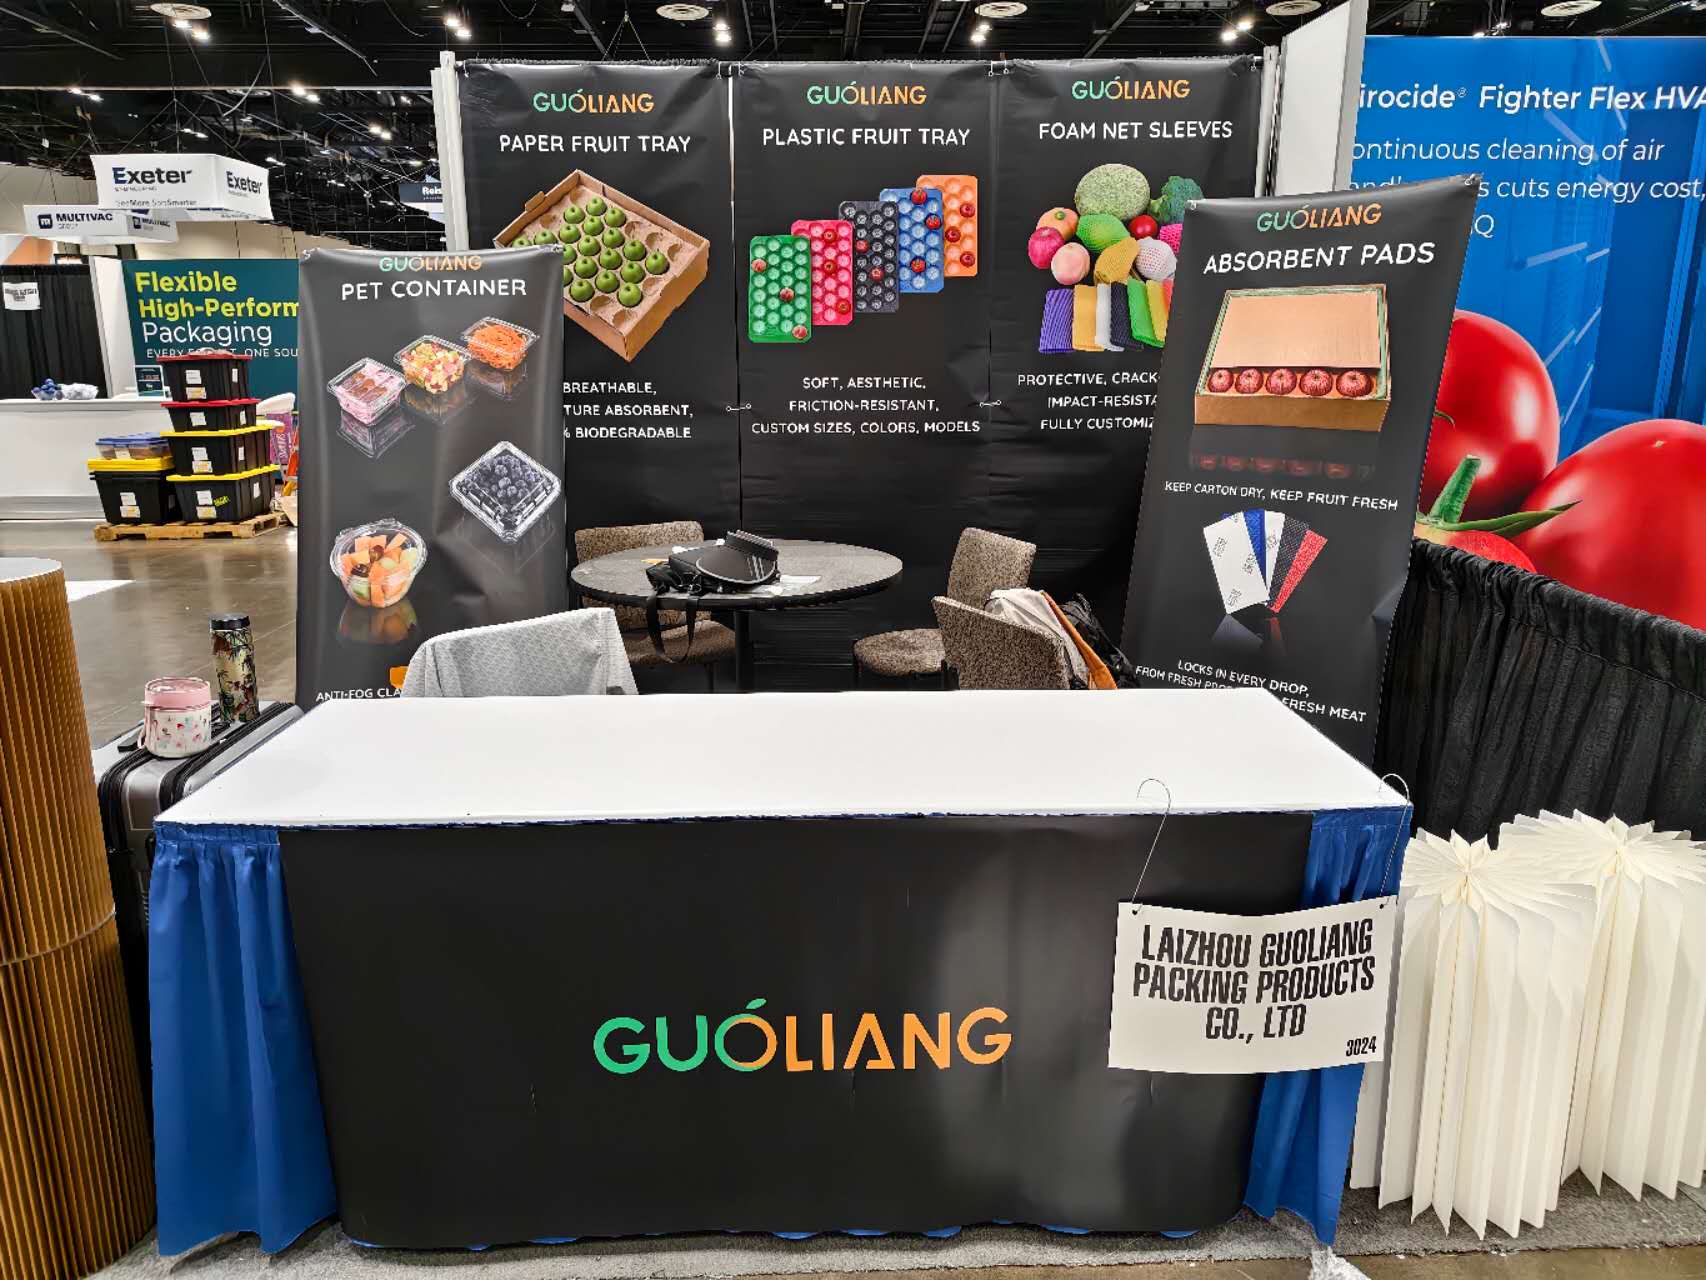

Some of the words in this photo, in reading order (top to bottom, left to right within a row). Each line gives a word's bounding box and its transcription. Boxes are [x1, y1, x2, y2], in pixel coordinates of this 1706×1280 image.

[1479, 84, 1581, 114] Fighter
[1589, 86, 1646, 110] Flex
[763, 128, 845, 146] PLASTIC
[852, 128, 911, 145] FRUIT
[918, 128, 970, 146] TRAY
[1039, 122, 1096, 140] FOAM
[1103, 122, 1143, 139] NET
[1149, 120, 1233, 138] SLEEVES
[499, 134, 564, 152] PAPER
[571, 135, 630, 153] FRUIT
[637, 135, 691, 153] TRAY
[1487, 138, 1594, 166] cleaning
[1602, 138, 1627, 160] of
[1632, 138, 1664, 160] air
[112, 167, 192, 184] Exeter
[226, 170, 263, 195] Exeter
[1496, 177, 1549, 198] cuts
[1556, 180, 1644, 203] energy
[1650, 178, 1706, 202] cost,
[56, 213, 113, 222] MULTIVAC
[1203, 245, 1352, 274] ABSORBENT
[1360, 242, 1436, 266] PADS
[134, 271, 237, 293] Flexible
[341, 282, 383, 301] PET
[391, 279, 527, 298] CONTAINER
[138, 297, 299, 321] High-Perform
[142, 321, 272, 346] Packaging
[244, 348, 270, 358] ONE
[274, 348, 298, 358] SOU
[563, 382, 657, 396] BREATHABLE,
[802, 377, 844, 391] SOFT,
[1017, 373, 1107, 386] PROTECTIVE,
[563, 404, 601, 416] TURE
[604, 404, 693, 418] ABSORBENT,
[575, 426, 691, 439] BIODEGRADABLE
[751, 422, 809, 434] CUSTOM
[813, 422, 856, 436] SIZES,
[924, 421, 981, 433] MODELS
[1040, 418, 1083, 430] FULLY
[1164, 480, 1192, 493] KEEP
[1194, 483, 1237, 496] CARTON
[1240, 487, 1266, 501] DRY,
[1270, 488, 1303, 502] KEEP
[1307, 492, 1349, 506] FRUIT
[1351, 496, 1399, 511] FRESH
[1178, 659, 1213, 676] LOCKS
[1215, 668, 1227, 680] IN
[1229, 671, 1266, 689] EVERY
[1269, 679, 1310, 698] DROP,
[315, 688, 373, 702] ANTI-FOG
[1135, 665, 1166, 681] FROM
[1168, 671, 1202, 689] FRESH
[1329, 705, 1367, 723] MEAT
[1142, 925, 1251, 968] LAIZHOU
[1259, 918, 1373, 968] GUOLIANG
[1133, 962, 1249, 1004] PACKING
[1255, 956, 1375, 1004] PRODUCTS
[1205, 1006, 1254, 1044] CO.,
[1263, 1004, 1307, 1039] LTD
[1345, 1036, 1376, 1057] 3024
